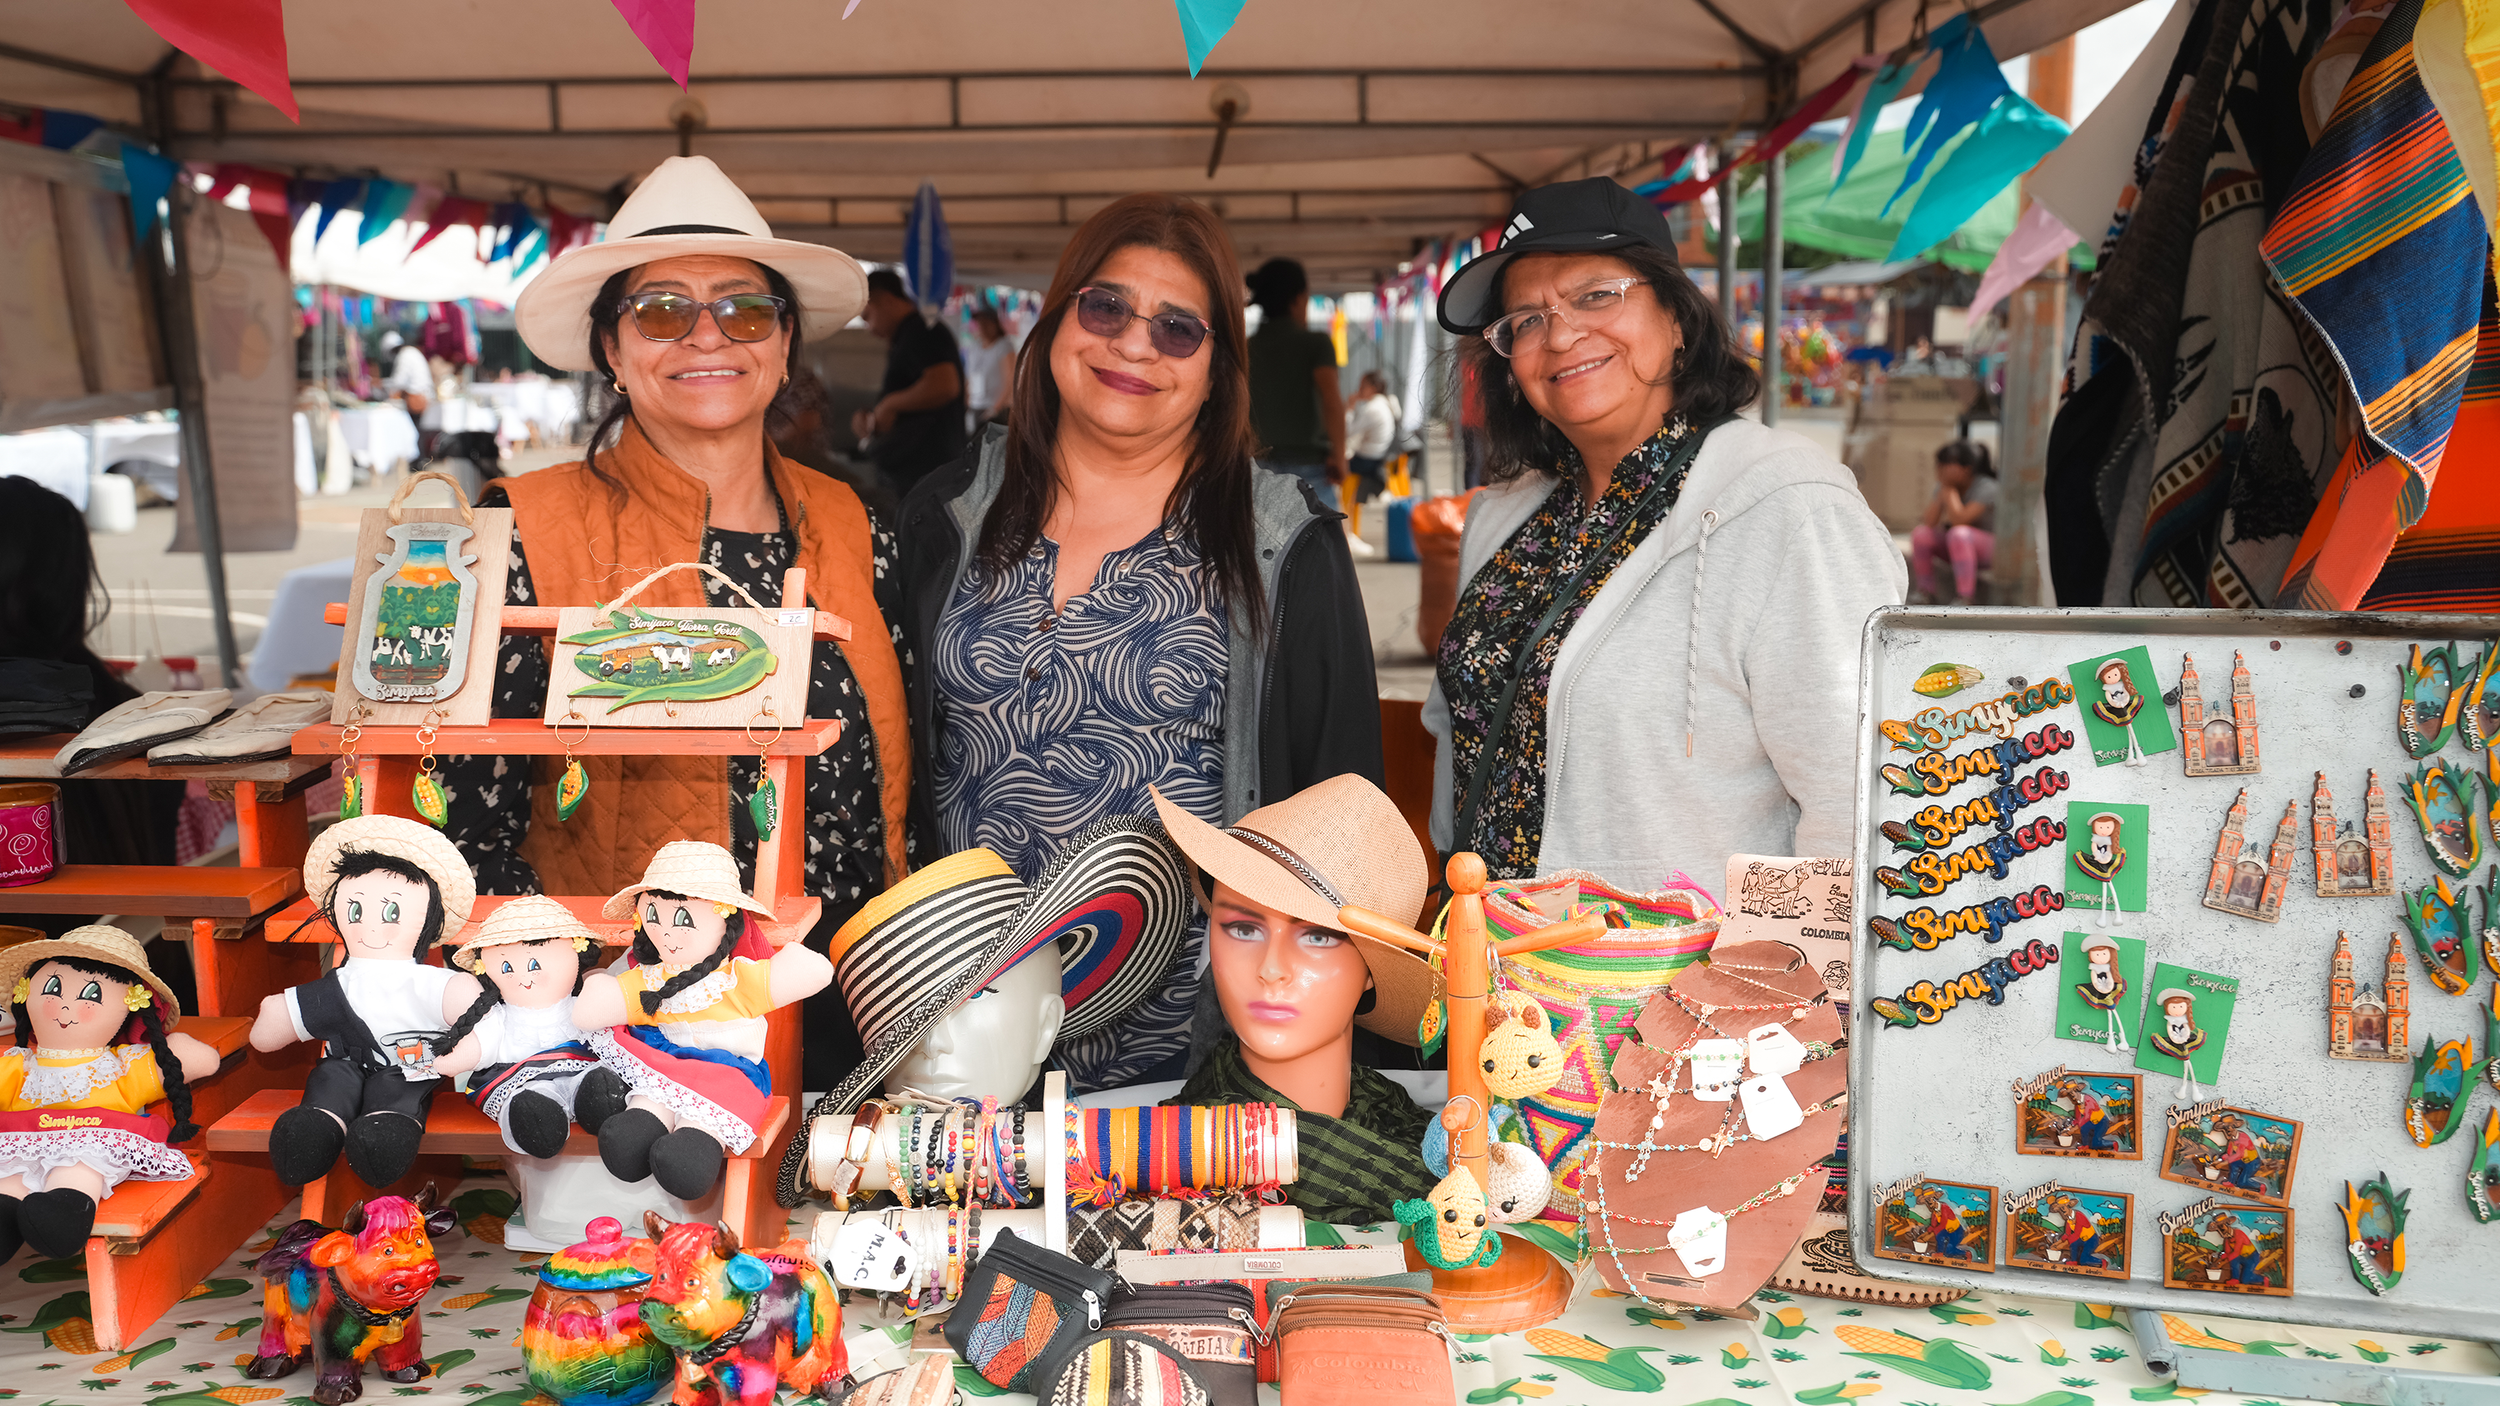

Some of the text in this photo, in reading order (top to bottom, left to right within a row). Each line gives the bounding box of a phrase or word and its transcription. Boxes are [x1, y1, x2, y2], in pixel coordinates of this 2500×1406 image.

[678, 619, 709, 633] Tierra
[713, 623, 743, 637] Fertil
[1915, 723, 2074, 795] Simijaca
[1915, 766, 2070, 849] Simijaca
[1910, 816, 2066, 895] Simijaca
[1801, 927, 1850, 941] COLOMBIA
[1904, 886, 2064, 950] Simijaca
[1905, 940, 2059, 1024] Simijaca
[39, 1113, 102, 1131] Simijaca
[1247, 1261, 1282, 1269] COLOMBIA
[1311, 1355, 1428, 1376] Colombia
